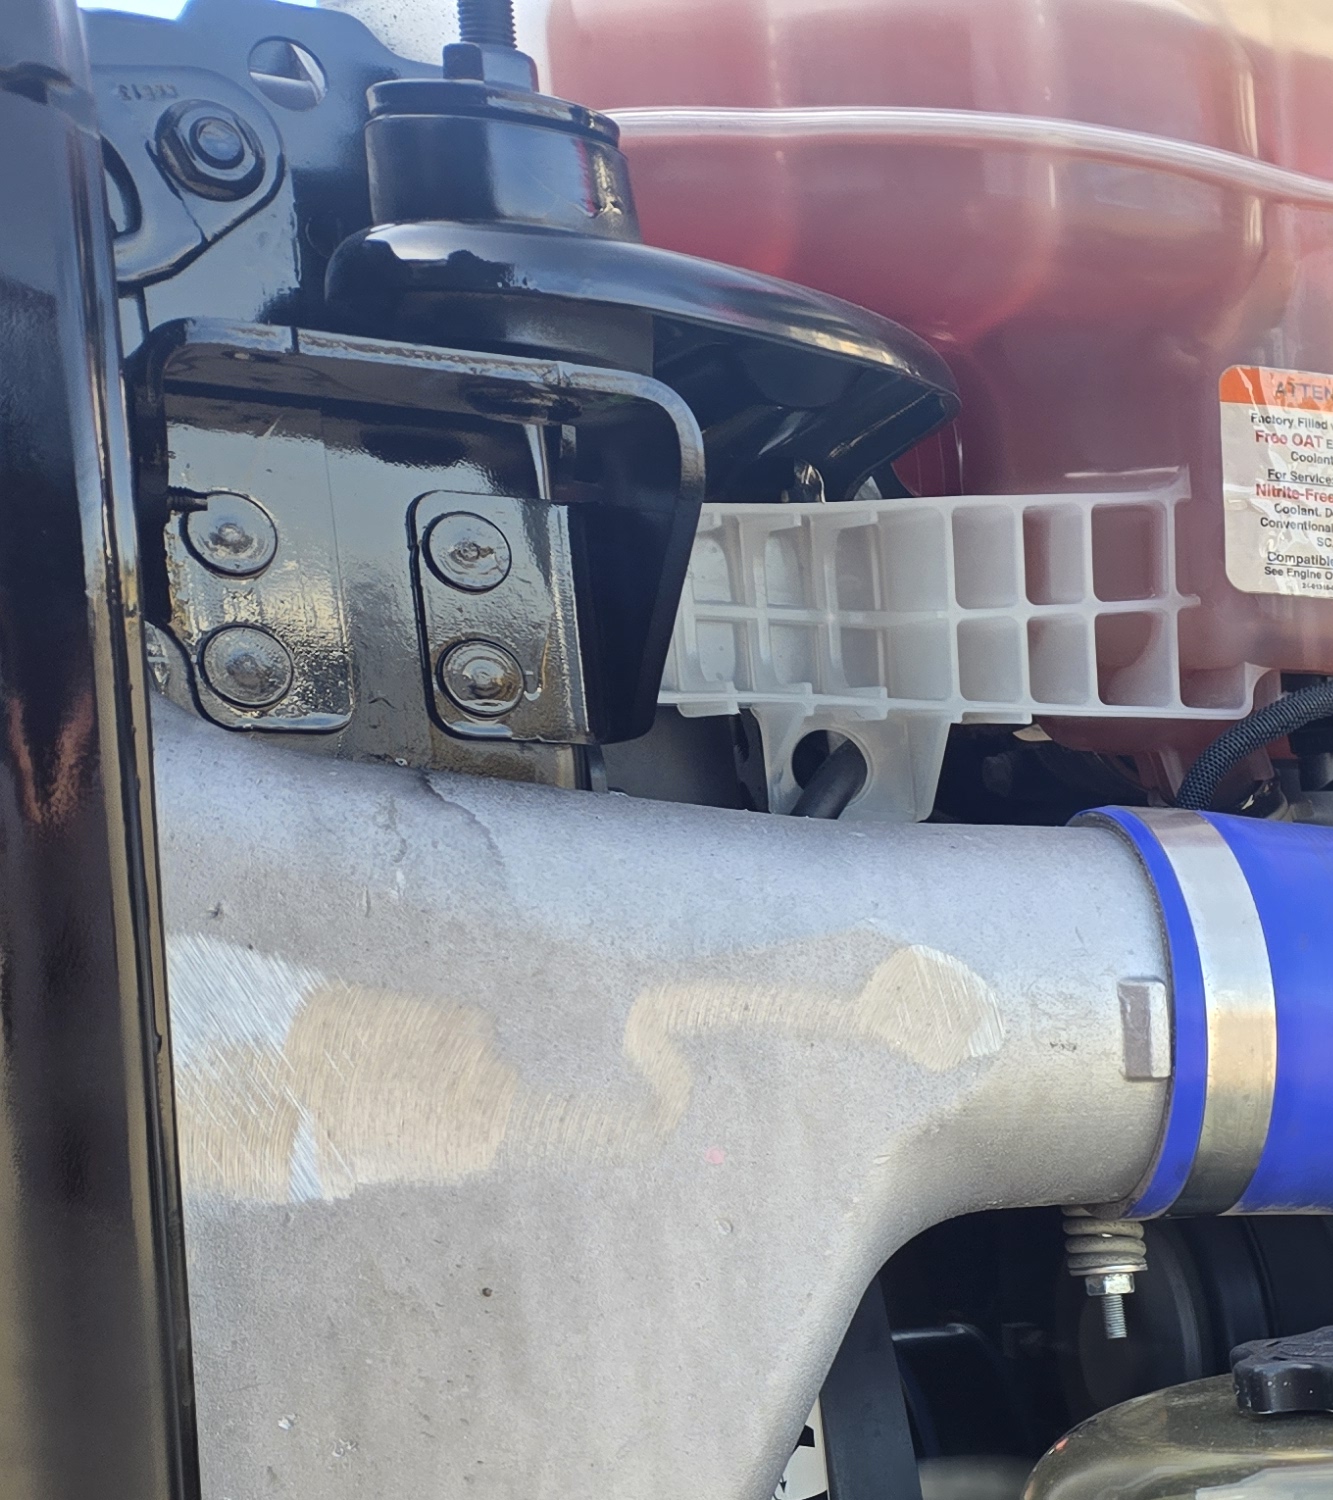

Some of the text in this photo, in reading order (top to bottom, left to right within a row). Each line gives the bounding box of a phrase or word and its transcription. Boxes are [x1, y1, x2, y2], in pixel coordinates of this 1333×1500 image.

[1251, 413, 1294, 430] Factory
[1298, 419, 1328, 430] Filled
[1255, 430, 1288, 445] Free
[1292, 433, 1324, 449] OAT
[1291, 451, 1333, 466] Coolant
[1268, 469, 1287, 481] For
[1260, 516, 1333, 533] Conventional
[1264, 566, 1284, 577] See
[1287, 568, 1322, 580] Engine
